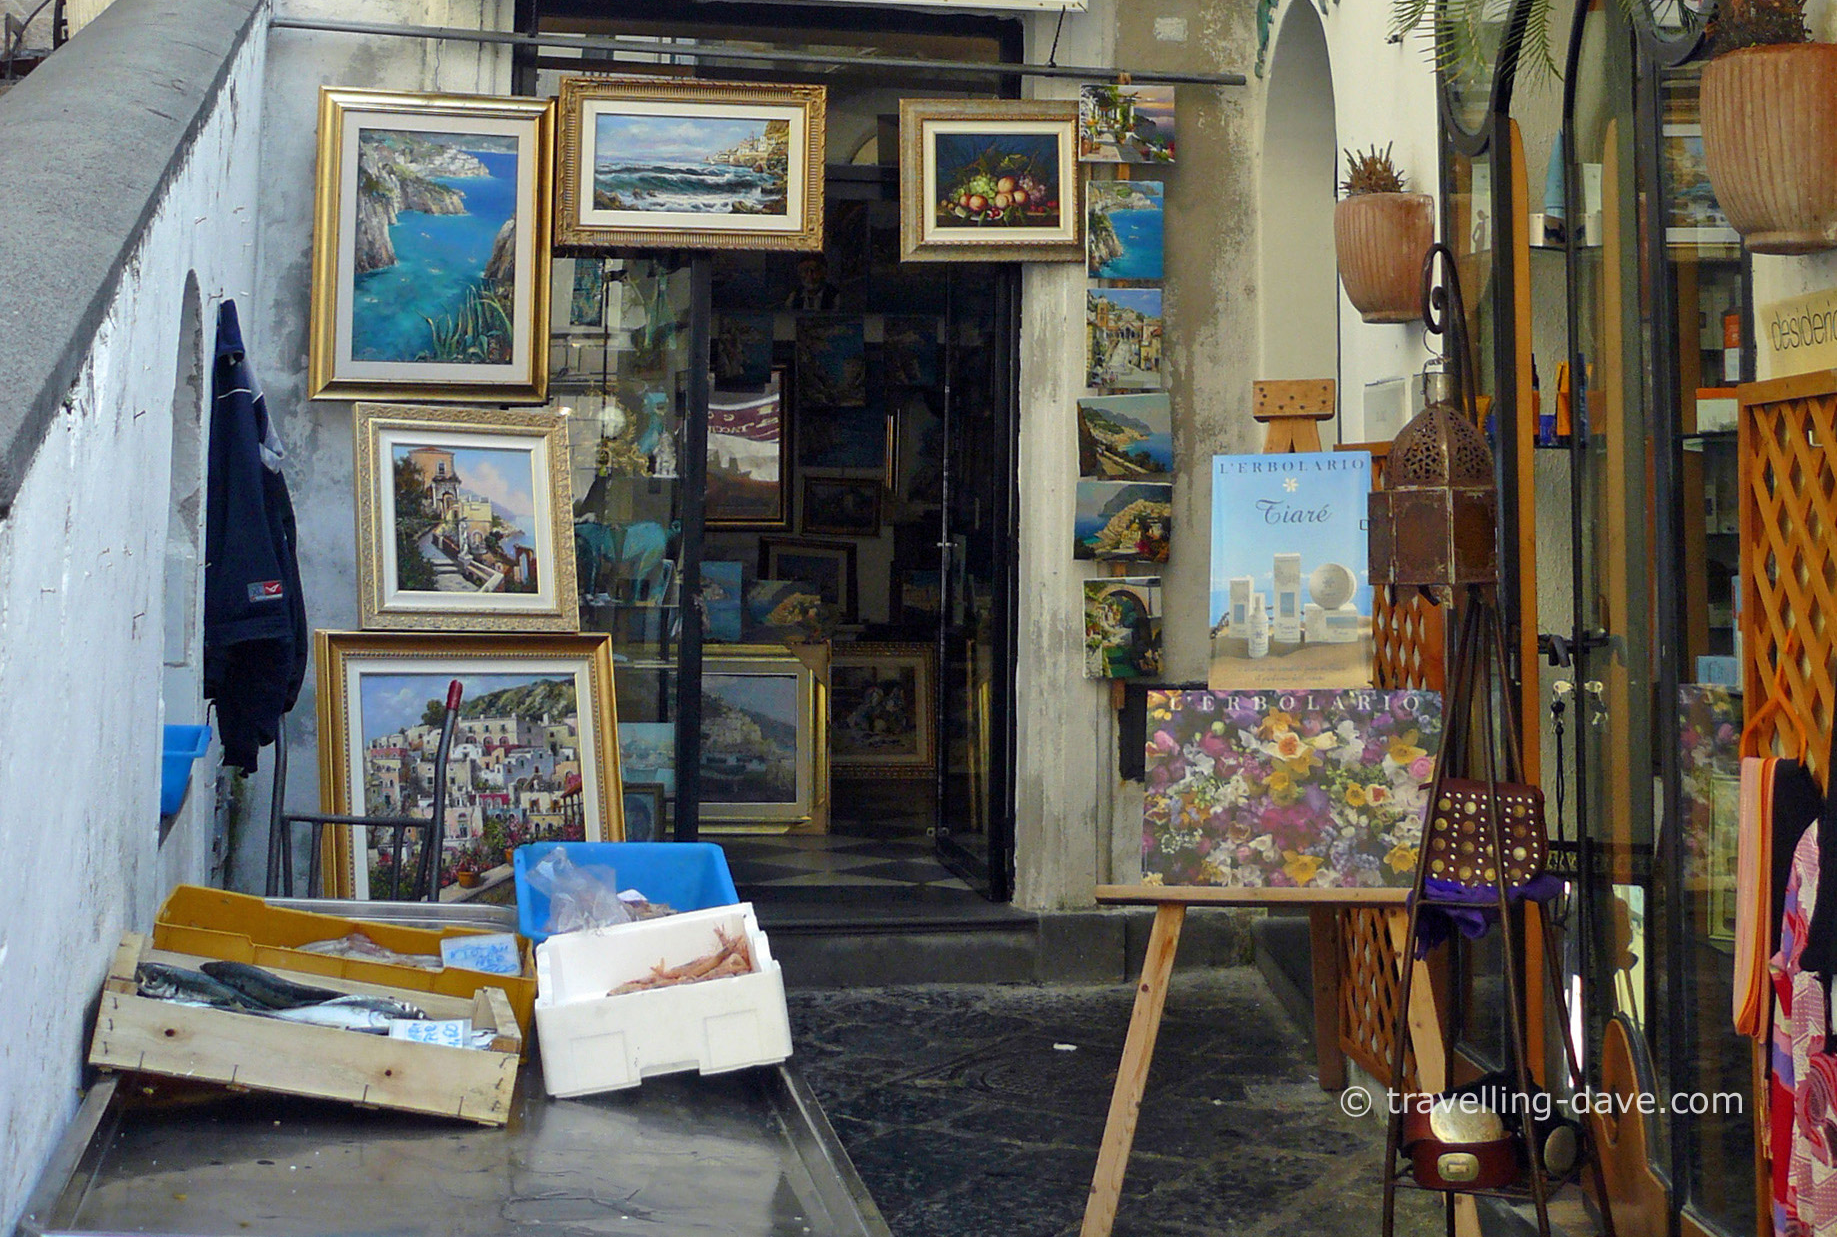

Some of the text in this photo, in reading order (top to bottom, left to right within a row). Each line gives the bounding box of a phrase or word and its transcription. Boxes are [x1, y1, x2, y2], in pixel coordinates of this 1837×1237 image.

[1220, 458, 1365, 474] L'ERBOLARIO
[1255, 499, 1332, 525] Tiaré
[1169, 695, 1420, 712] L'ERBOLARIO
